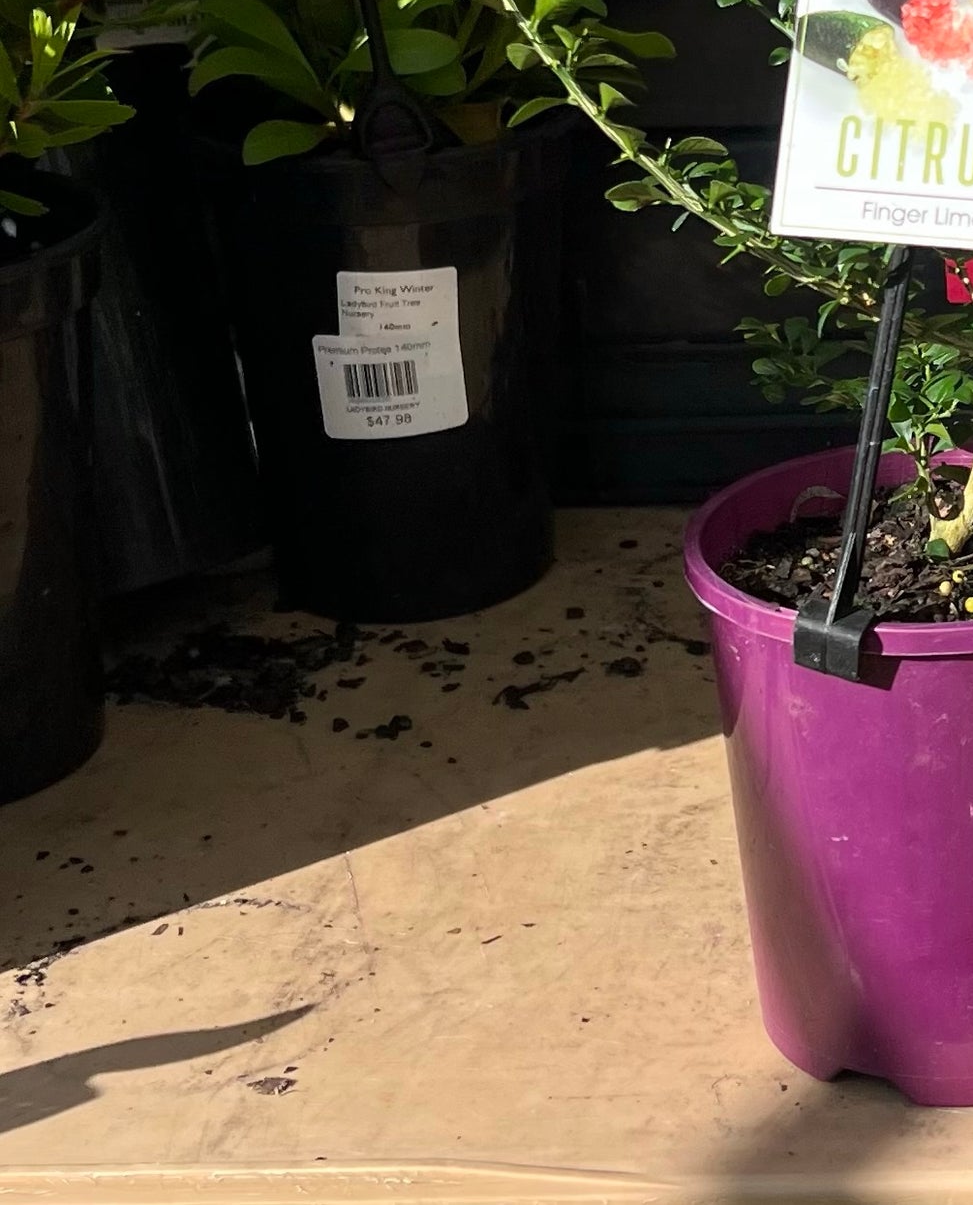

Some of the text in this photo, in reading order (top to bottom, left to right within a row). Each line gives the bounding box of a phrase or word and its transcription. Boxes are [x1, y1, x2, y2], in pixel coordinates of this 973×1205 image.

[861, 201, 928, 226] Finger
[354, 284, 434, 296] Pro King Winter
[402, 299, 421, 307] Tree
[341, 308, 375, 319] Nursery
[318, 341, 431, 355] Premium Protea 140mm
